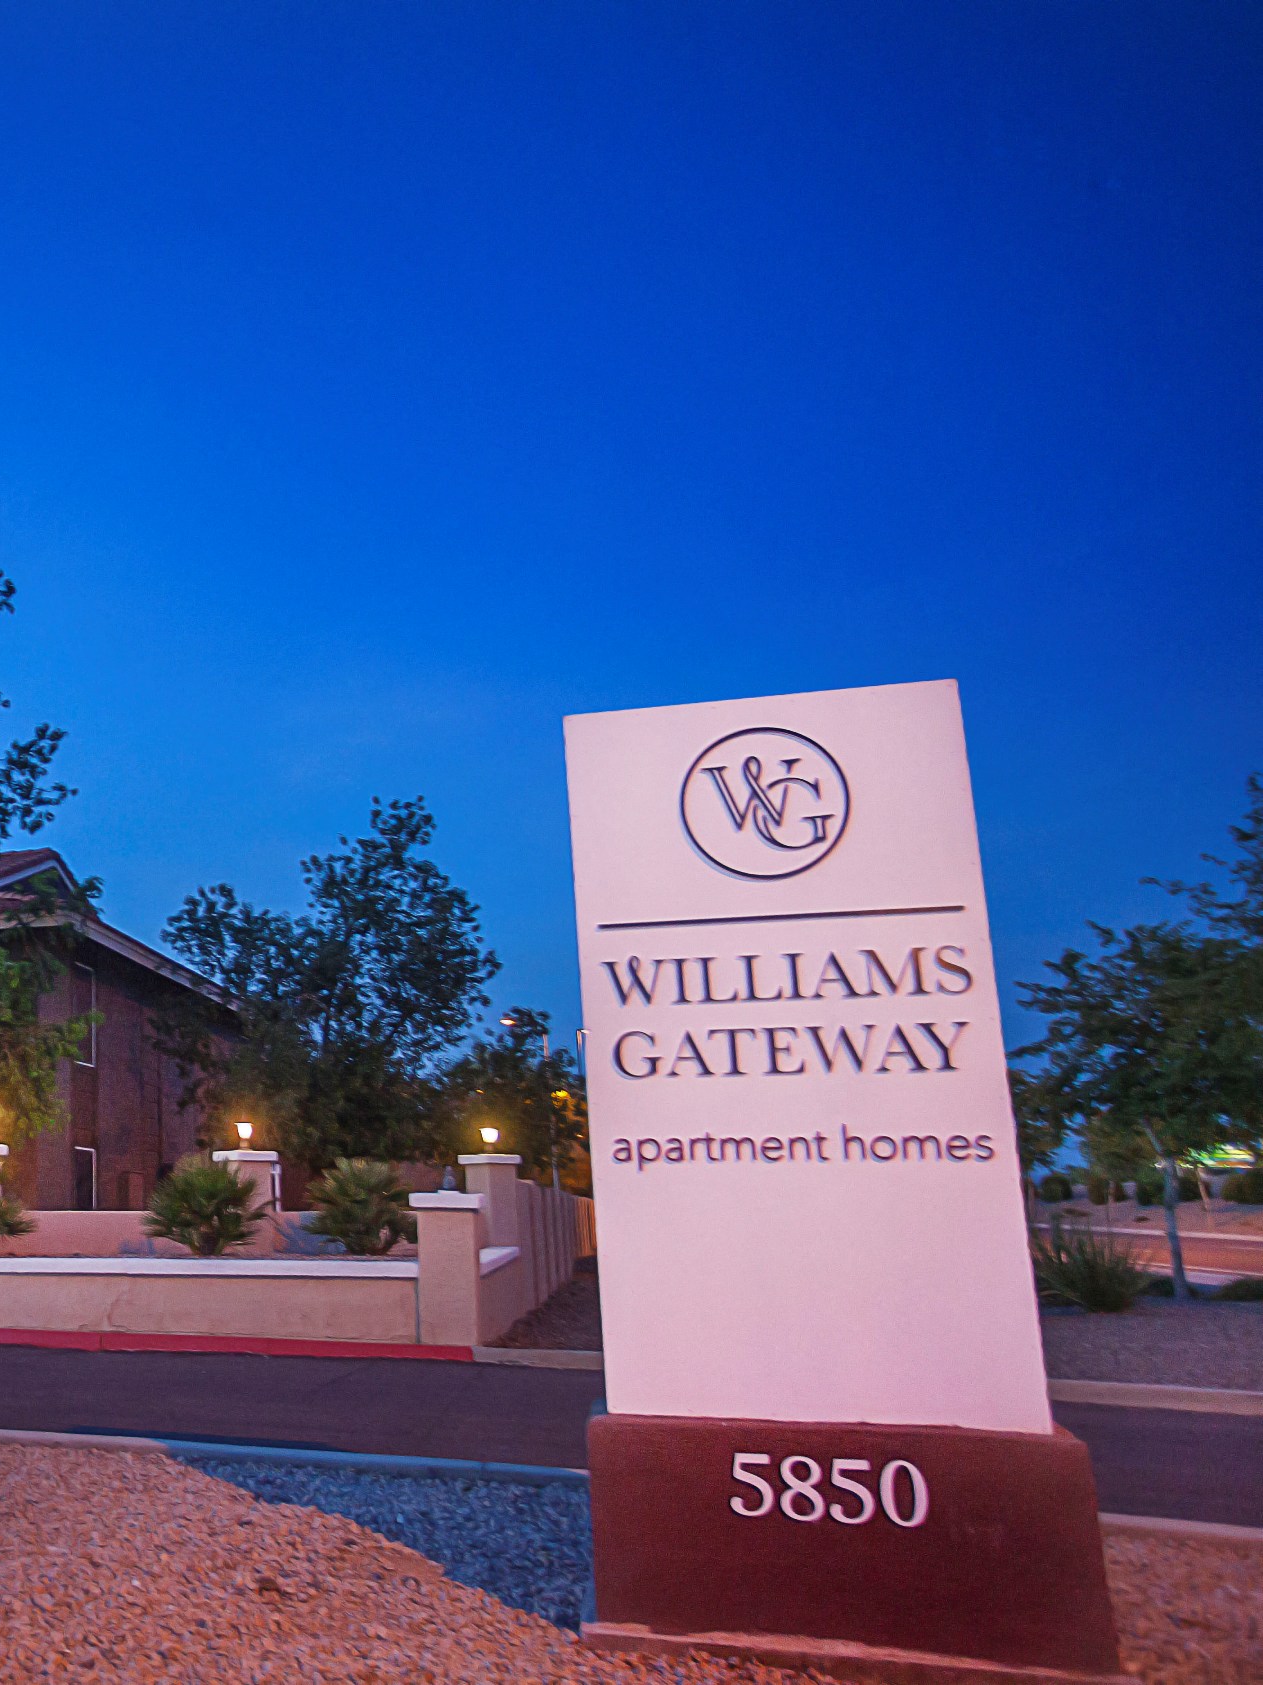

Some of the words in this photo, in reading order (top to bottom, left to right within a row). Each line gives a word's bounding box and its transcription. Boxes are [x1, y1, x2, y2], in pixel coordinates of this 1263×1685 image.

[601, 945, 973, 1007] WILLIAMS
[611, 1021, 970, 1080] GATEWAY
[611, 1131, 829, 1170] apartment
[840, 1123, 995, 1163] homes
[729, 1452, 929, 1528] 5850
